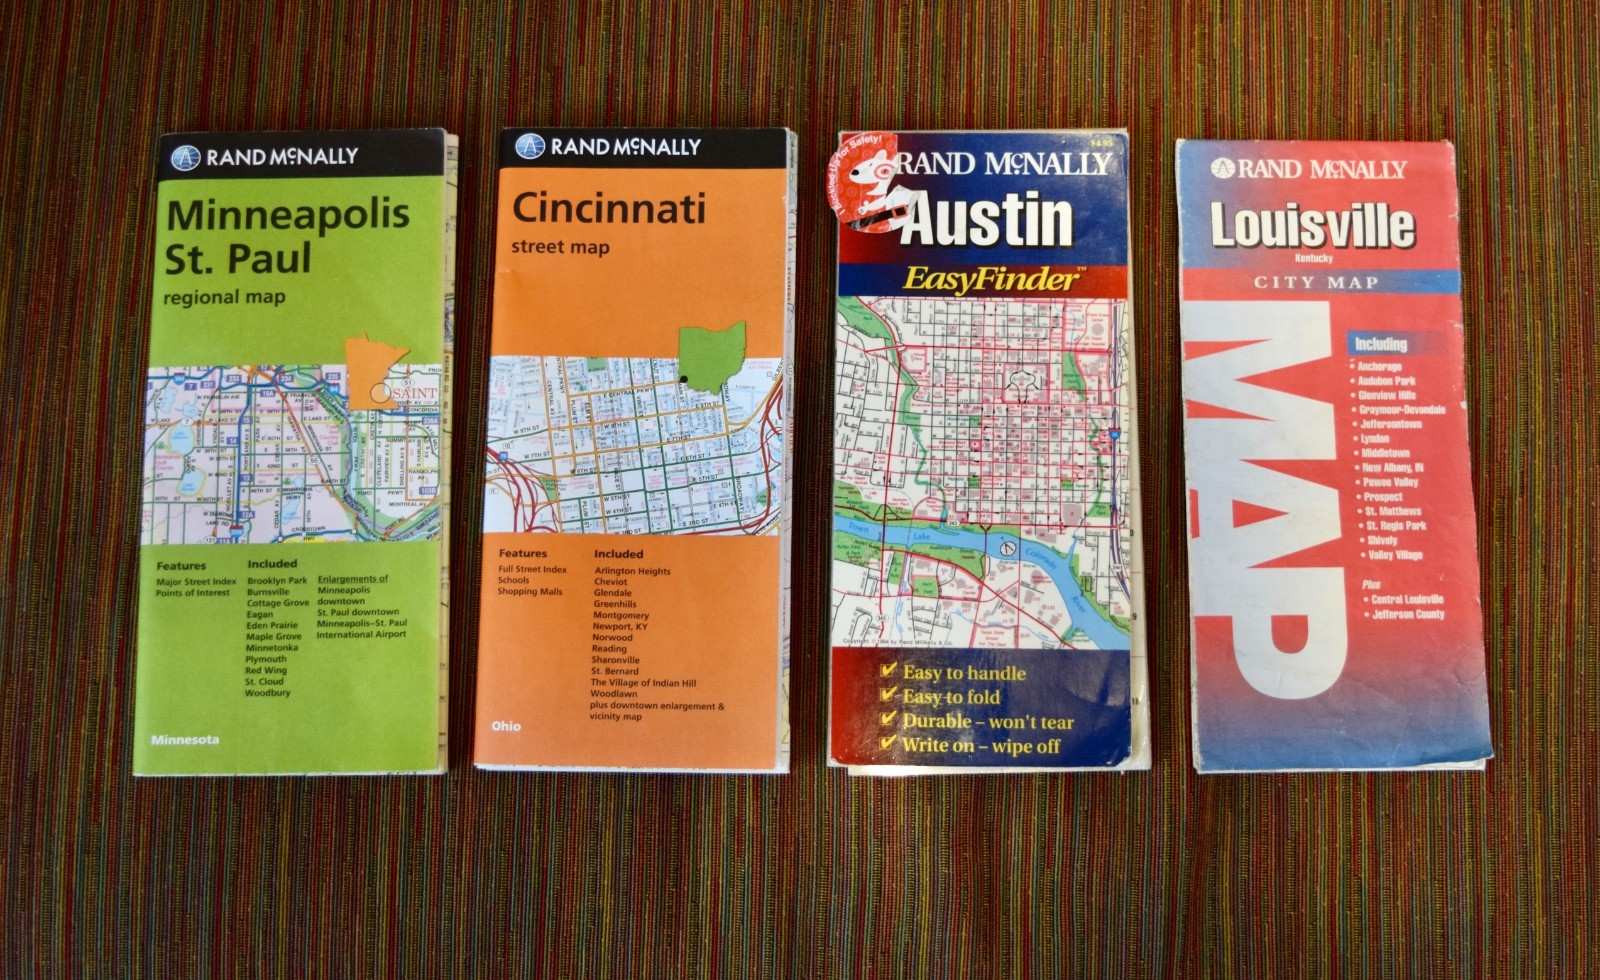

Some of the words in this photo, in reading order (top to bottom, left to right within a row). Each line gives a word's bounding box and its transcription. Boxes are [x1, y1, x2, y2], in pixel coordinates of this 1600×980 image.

[552, 139, 609, 155] RAND
[838, 147, 850, 159] for
[850, 135, 882, 148] Safety!
[207, 149, 266, 166] RAND
[899, 152, 975, 175] RAND
[1238, 160, 1302, 178] RAND
[513, 191, 705, 224] Cincinnati
[168, 196, 410, 238] Minneapolis
[900, 190, 1074, 247] Austin
[1211, 202, 1416, 248] Louisville
[512, 240, 564, 253] street
[571, 242, 610, 258] map
[166, 243, 212, 275] St.
[229, 241, 310, 274] Paul
[1295, 253, 1333, 264] Kentucky
[1254, 276, 1314, 289] CITY
[1328, 276, 1378, 289] MAP
[163, 289, 239, 308] regional
[246, 290, 286, 307] map
[1355, 337, 1407, 353] Including
[1358, 362, 1402, 372] Anchorage
[1358, 376, 1392, 385] Audubon
[1395, 376, 1416, 385] Park
[392, 388, 437, 399] SAINT
[1358, 391, 1396, 400] Glenview
[1399, 391, 1416, 400] Hills
[1360, 405, 1446, 415] Graymoor-Devondale
[1361, 420, 1422, 428] Jeffersontown
[1361, 434, 1389, 444] Lyndon
[1362, 448, 1410, 458] Middletown
[1362, 463, 1381, 472] New
[1384, 463, 1412, 473] Albany,
[1415, 463, 1424, 472] IN
[1363, 478, 1391, 486] Pewee
[1394, 478, 1418, 488] Valley
[736, 477, 744, 510] BROADWAY
[1364, 492, 1403, 502] Prospect
[1183, 301, 1347, 700] MAP
[1365, 507, 1377, 516] St.
[1380, 507, 1422, 516] Matthews
[848, 522, 868, 533] Town
[1366, 521, 1378, 530] St.
[1381, 521, 1403, 531] Regis
[1406, 521, 1427, 530] Park
[1368, 536, 1397, 546] Shively
[499, 549, 547, 558] Features
[594, 549, 643, 559] Included
[1369, 550, 1393, 560] Valley
[1396, 550, 1423, 560] Village
[248, 559, 298, 569] Included
[1025, 548, 1057, 570] Colorado
[157, 561, 206, 571] Features
[498, 565, 514, 574] Full
[516, 566, 541, 574] Street
[543, 566, 567, 574] Index
[595, 567, 636, 576] Arlington
[638, 567, 670, 576] Heights
[156, 578, 182, 588] Major
[184, 577, 211, 586] Street
[213, 577, 237, 585] Index
[247, 576, 286, 586] Brooklyn
[289, 576, 307, 585] Park
[318, 575, 376, 585] Enlargements
[380, 574, 388, 583] of
[498, 576, 529, 584] Schools
[594, 578, 628, 586] Cheviot
[1362, 580, 1381, 590] Plus
[247, 588, 290, 596] Burnsville
[317, 586, 370, 595] Minneapolis
[497, 588, 537, 597] Shopping
[540, 588, 563, 596] Malls
[594, 589, 632, 597] Glendale
[247, 599, 282, 609] Cottage
[284, 599, 310, 607] Grove
[317, 597, 365, 606] downtown
[594, 600, 636, 608] Greenhills
[1371, 594, 1402, 604] Central
[1405, 594, 1444, 604] Louisville
[247, 610, 273, 620] Eagan
[317, 608, 328, 617] St.
[330, 608, 349, 616] Paul
[352, 608, 399, 616] downtown
[593, 611, 649, 621] Montgomery
[1372, 609, 1413, 620] Jefferson
[1416, 610, 1444, 620] County
[593, 623, 633, 632] Newport,
[246, 633, 273, 642] Maple
[317, 630, 373, 639] International
[375, 630, 406, 639] Airport
[592, 633, 633, 642] Norwood
[246, 644, 298, 652] Minnetonka
[592, 645, 627, 654] Reading
[245, 655, 287, 665] Plymouth
[592, 656, 640, 664] Sharonville
[245, 666, 262, 674] Red
[264, 666, 288, 676] Wing
[591, 667, 603, 675] St.
[605, 667, 639, 675] Bernard
[903, 665, 942, 683] Easy
[947, 667, 963, 680] to
[967, 666, 1026, 681] handle
[245, 678, 256, 686] St.
[259, 677, 284, 686] Cloud
[591, 678, 607, 687] The
[609, 678, 639, 688] Village
[641, 678, 650, 687] of
[653, 679, 680, 687] Indian
[682, 679, 697, 687] Hill
[245, 688, 291, 698] Woodbury
[903, 689, 942, 708] Easy
[947, 691, 963, 704] to
[967, 690, 1000, 704] fold
[590, 701, 608, 711] plus
[610, 701, 658, 710] downtown
[660, 702, 715, 712] enlargement
[590, 712, 620, 722] vicinity
[903, 713, 972, 729] Durable
[989, 715, 1037, 730] won't
[1041, 717, 1074, 730] tear
[491, 721, 521, 732] Ohio
[151, 735, 220, 746] Minnesota
[902, 736, 949, 753] Write
[952, 741, 975, 753] on
[992, 739, 1036, 757] wipe
[1040, 739, 1061, 754] off
